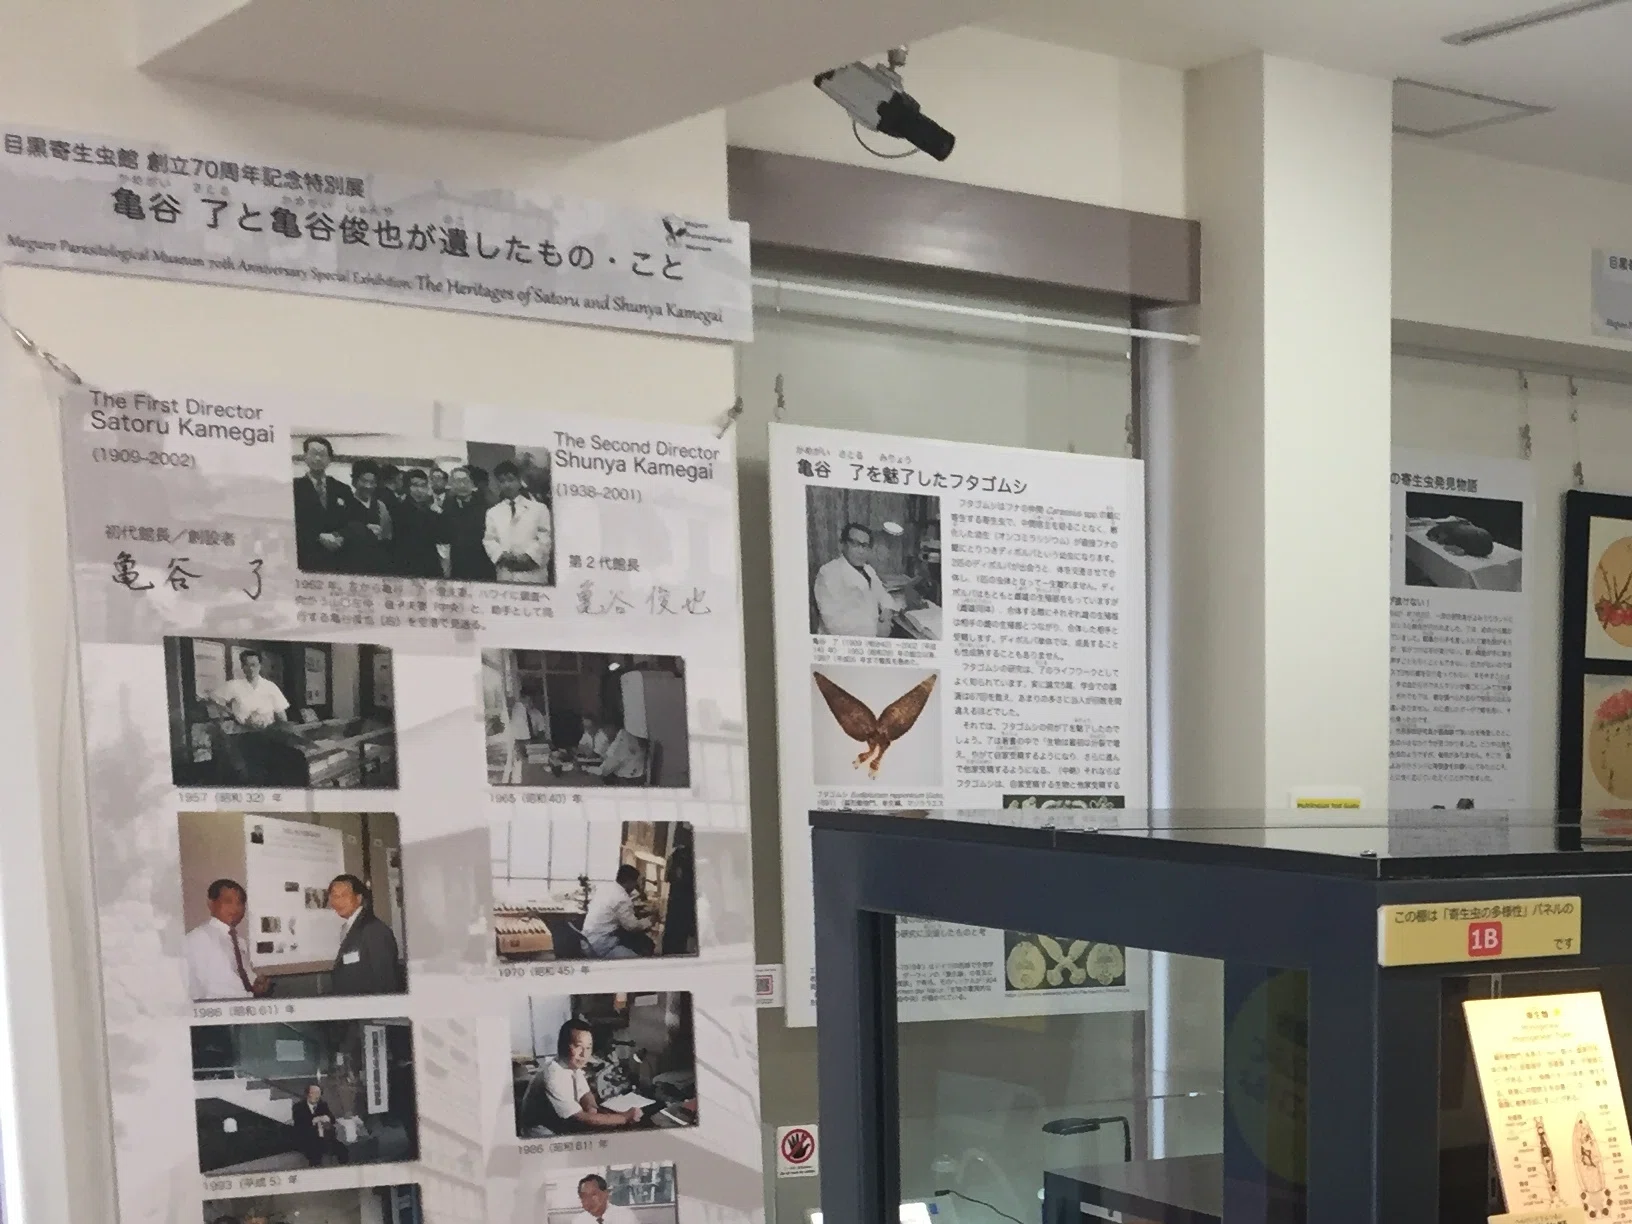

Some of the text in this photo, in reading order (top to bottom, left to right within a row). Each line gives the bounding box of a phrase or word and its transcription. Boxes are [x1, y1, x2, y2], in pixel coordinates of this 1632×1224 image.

[4, 133, 366, 198] 目黒寄生虫館 創立70周年記念特別展
[111, 187, 182, 224] 亀谷
[418, 274, 444, 294] The
[516, 283, 533, 306] of
[534, 285, 580, 308] Satoru
[583, 293, 611, 312] and
[613, 294, 664, 318] Shunya
[666, 302, 724, 327] Kamegai
[89, 390, 264, 420] The First Director
[91, 410, 275, 447] Satoru Kamegai
[553, 430, 720, 462] The Second Director
[555, 450, 715, 483] Shunya Kamegai
[797, 458, 1029, 496] 亀谷 了を魅了したフタゴムシ
[1471, 927, 1499, 950] 1B
[1553, 937, 1574, 950] です
